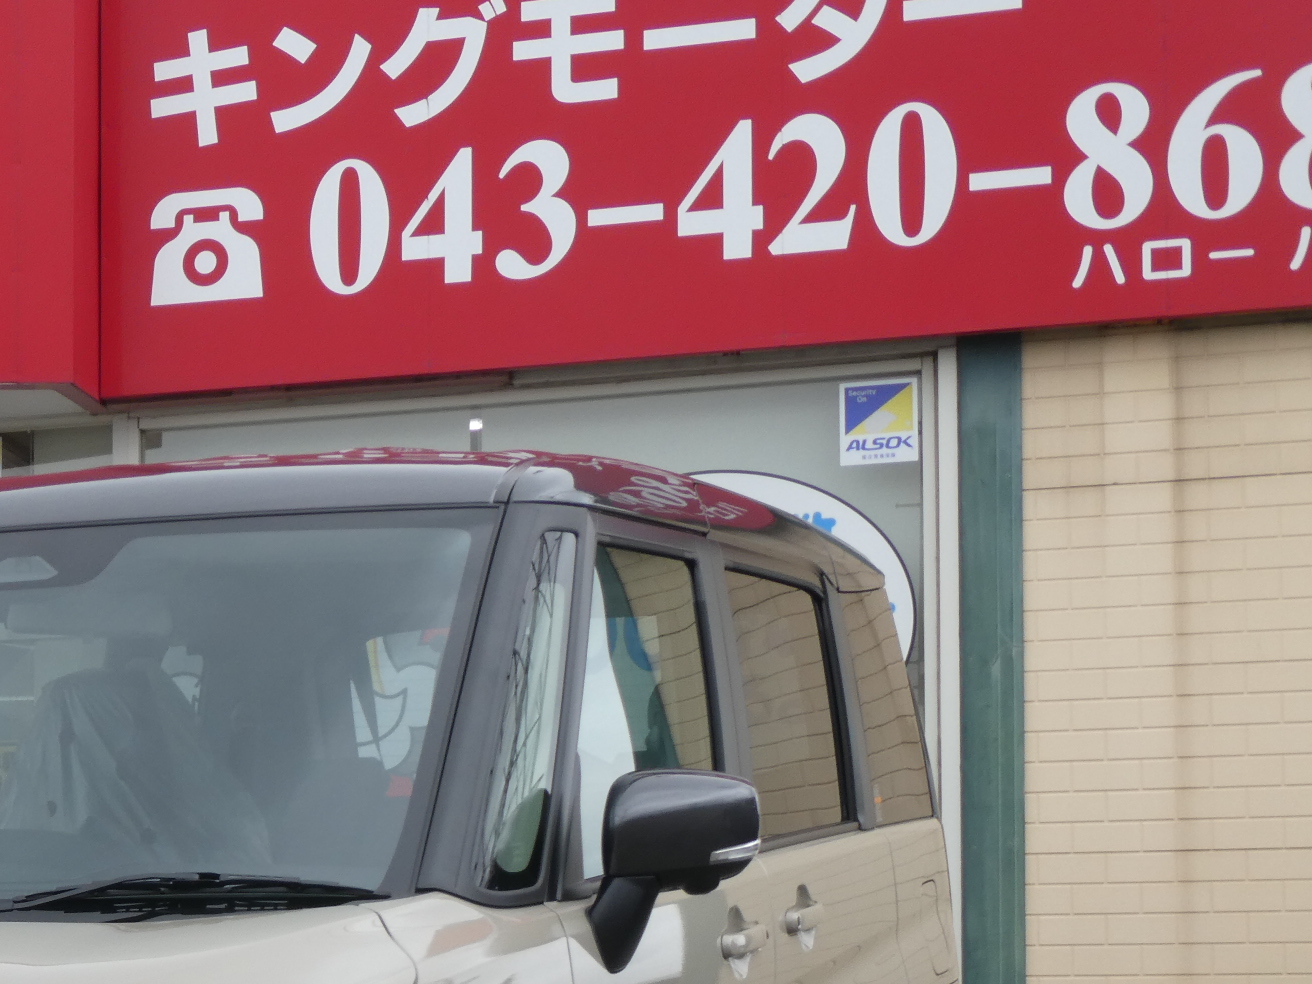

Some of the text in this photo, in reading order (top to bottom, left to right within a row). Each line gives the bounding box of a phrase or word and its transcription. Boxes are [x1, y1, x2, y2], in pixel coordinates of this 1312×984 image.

[151, 0, 1023, 147] キングモーター
[845, 435, 914, 452] ALSOK
